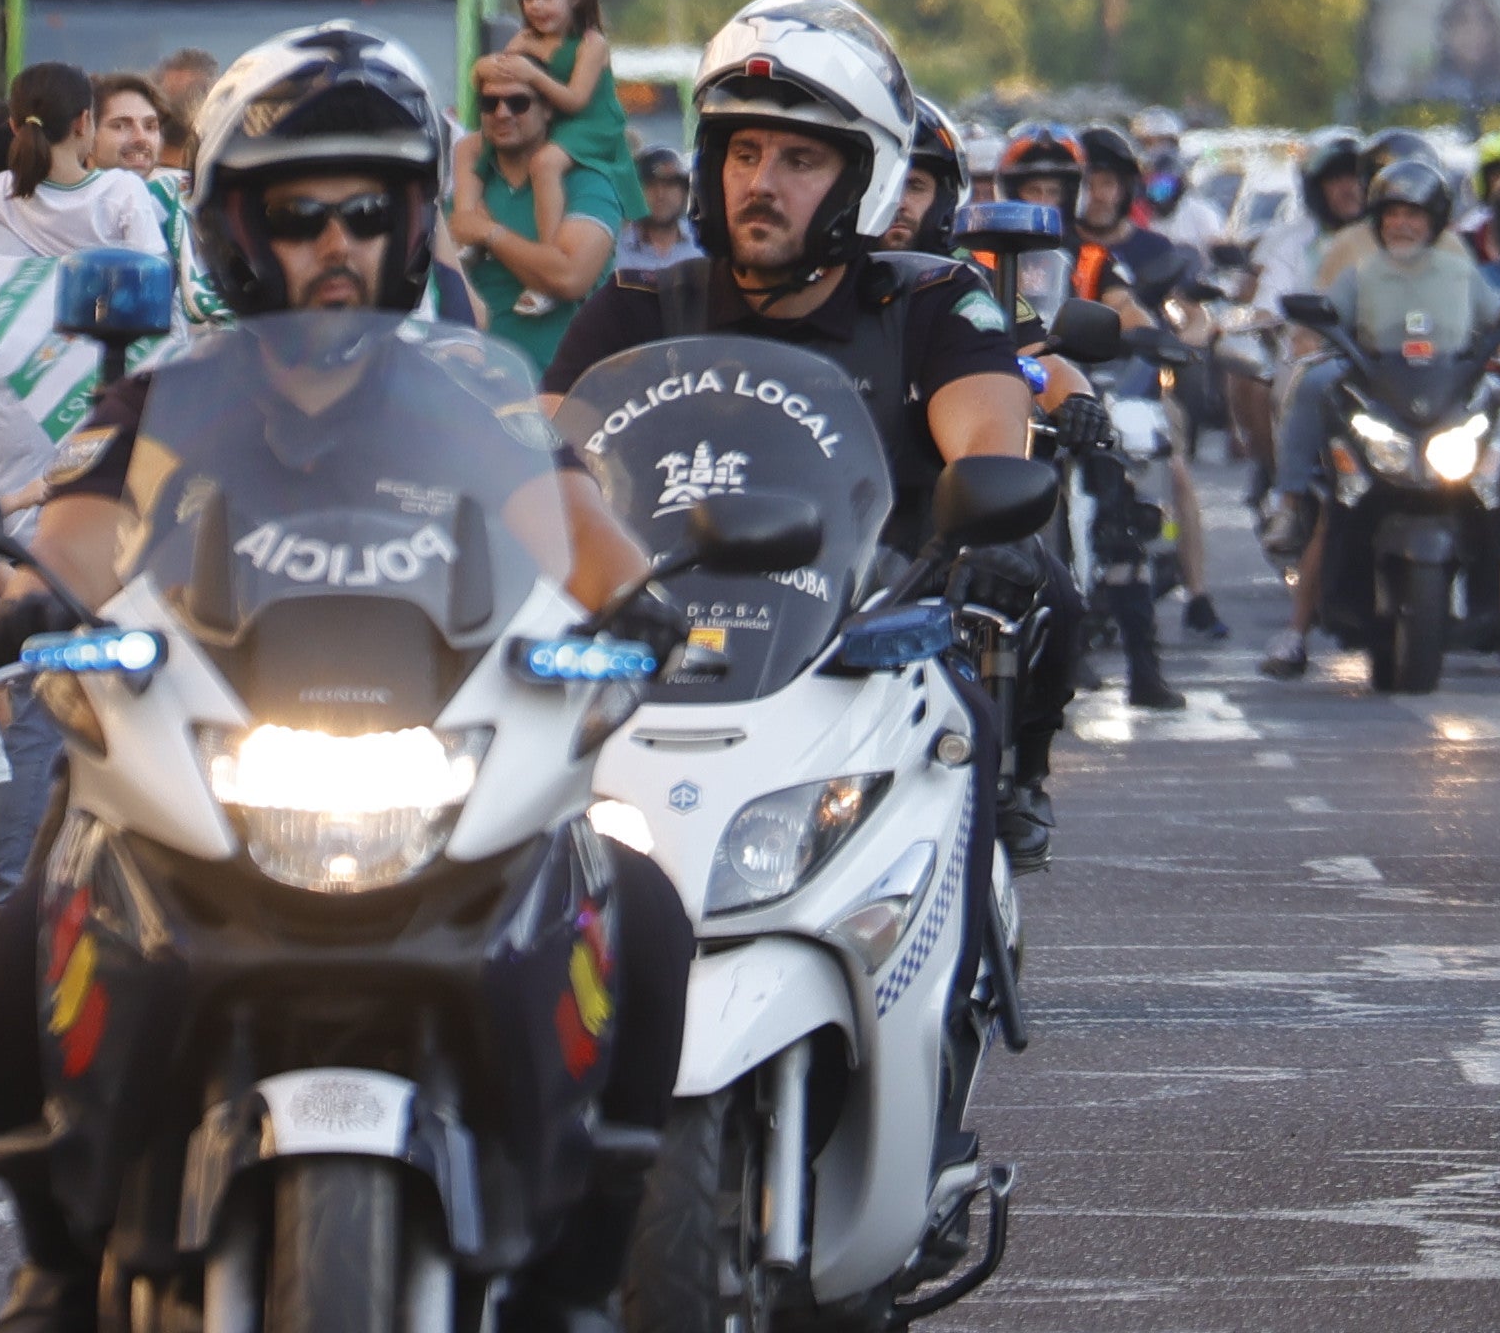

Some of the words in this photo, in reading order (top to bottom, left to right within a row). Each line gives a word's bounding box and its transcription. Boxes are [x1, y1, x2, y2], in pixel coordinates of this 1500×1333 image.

[583, 369, 724, 456] POLICIA
[733, 370, 846, 459] LOCAL
[707, 617, 770, 631] Humanidad
